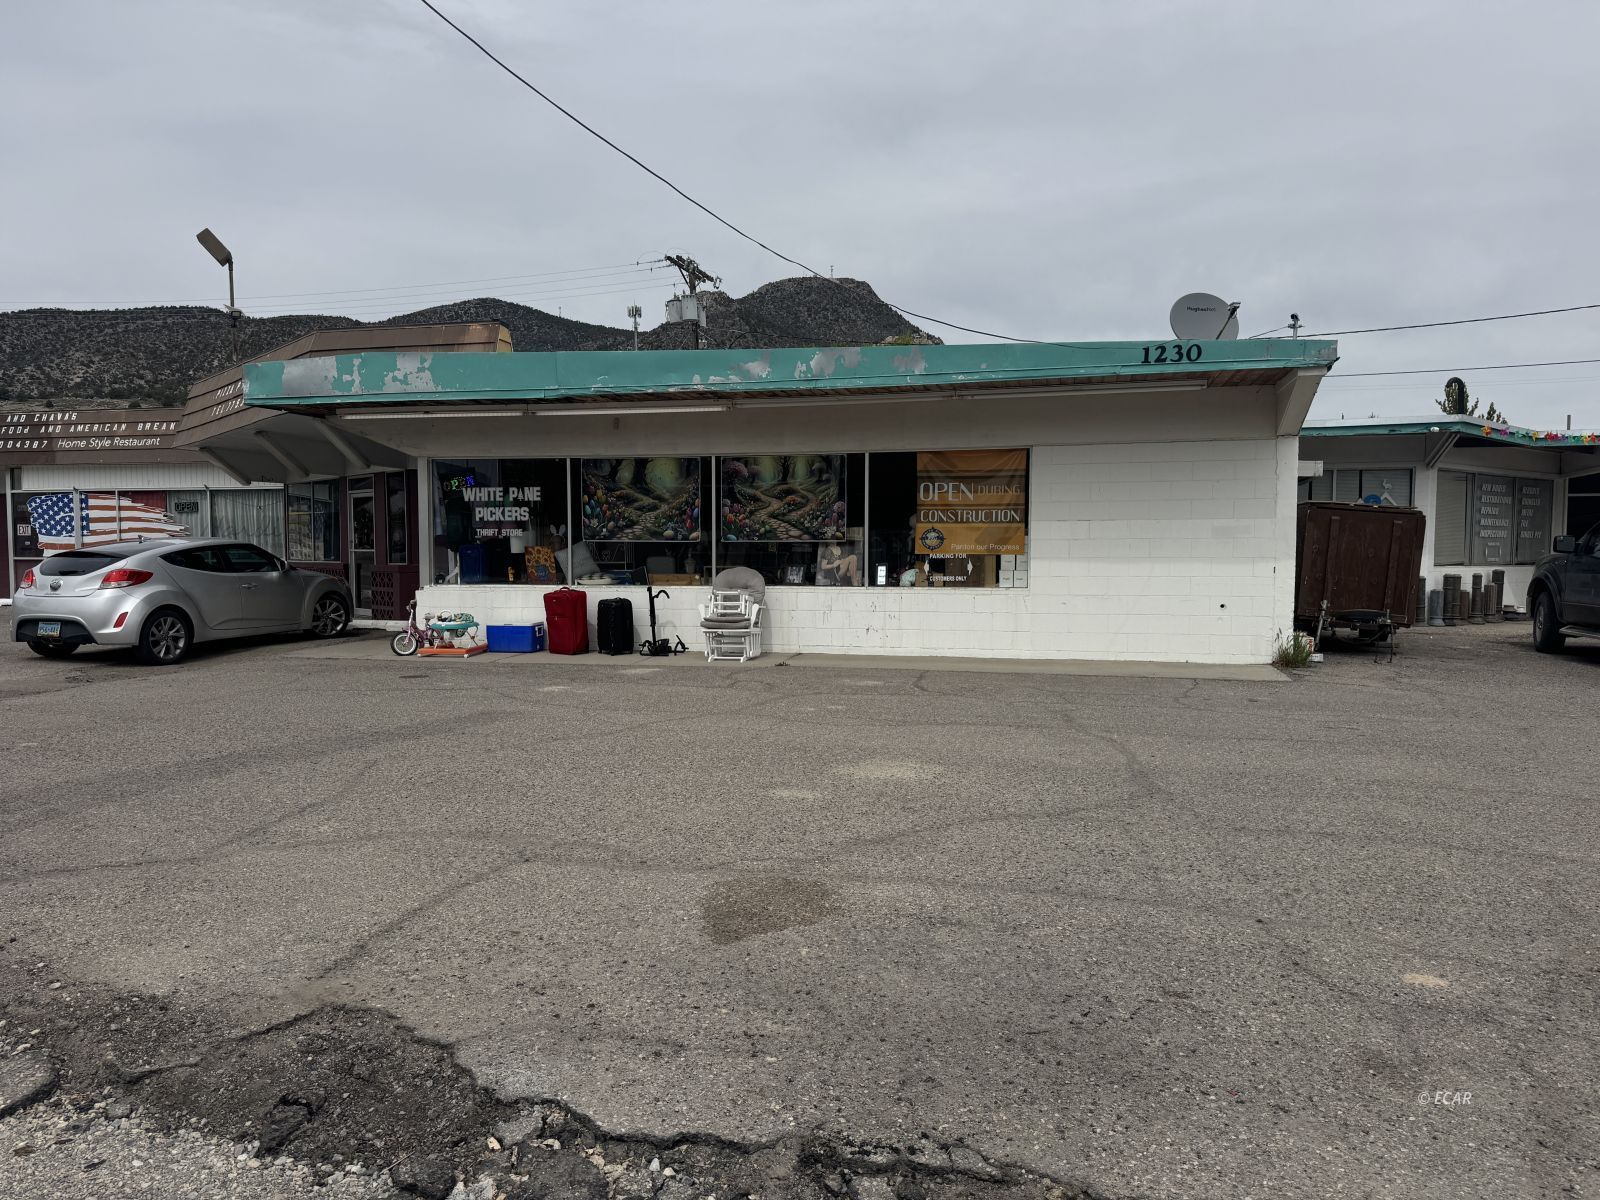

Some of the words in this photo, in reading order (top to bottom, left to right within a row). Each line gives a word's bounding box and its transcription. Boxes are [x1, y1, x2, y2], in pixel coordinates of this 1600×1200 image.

[1141, 344, 1202, 363] 1230
[6, 414, 27, 423] AND
[34, 411, 78, 422] CHAVA'S
[39, 425, 62, 433] AND
[69, 423, 127, 433] AMERICAN
[137, 422, 176, 431] BREAK
[57, 439, 87, 449] Home
[88, 437, 112, 450] Style
[113, 436, 161, 447] Restaurant
[463, 487, 503, 501] WHITE
[920, 482, 973, 501] OPEN
[978, 485, 1020, 495] DURING
[174, 502, 199, 512] OPEN
[475, 507, 529, 521] PICKERS
[920, 509, 1020, 523] CONSTRUCTION
[19, 525, 30, 535] EXIT
[476, 528, 499, 537] THRIFT
[501, 528, 523, 537] STORE
[989, 543, 1020, 552] Progress
